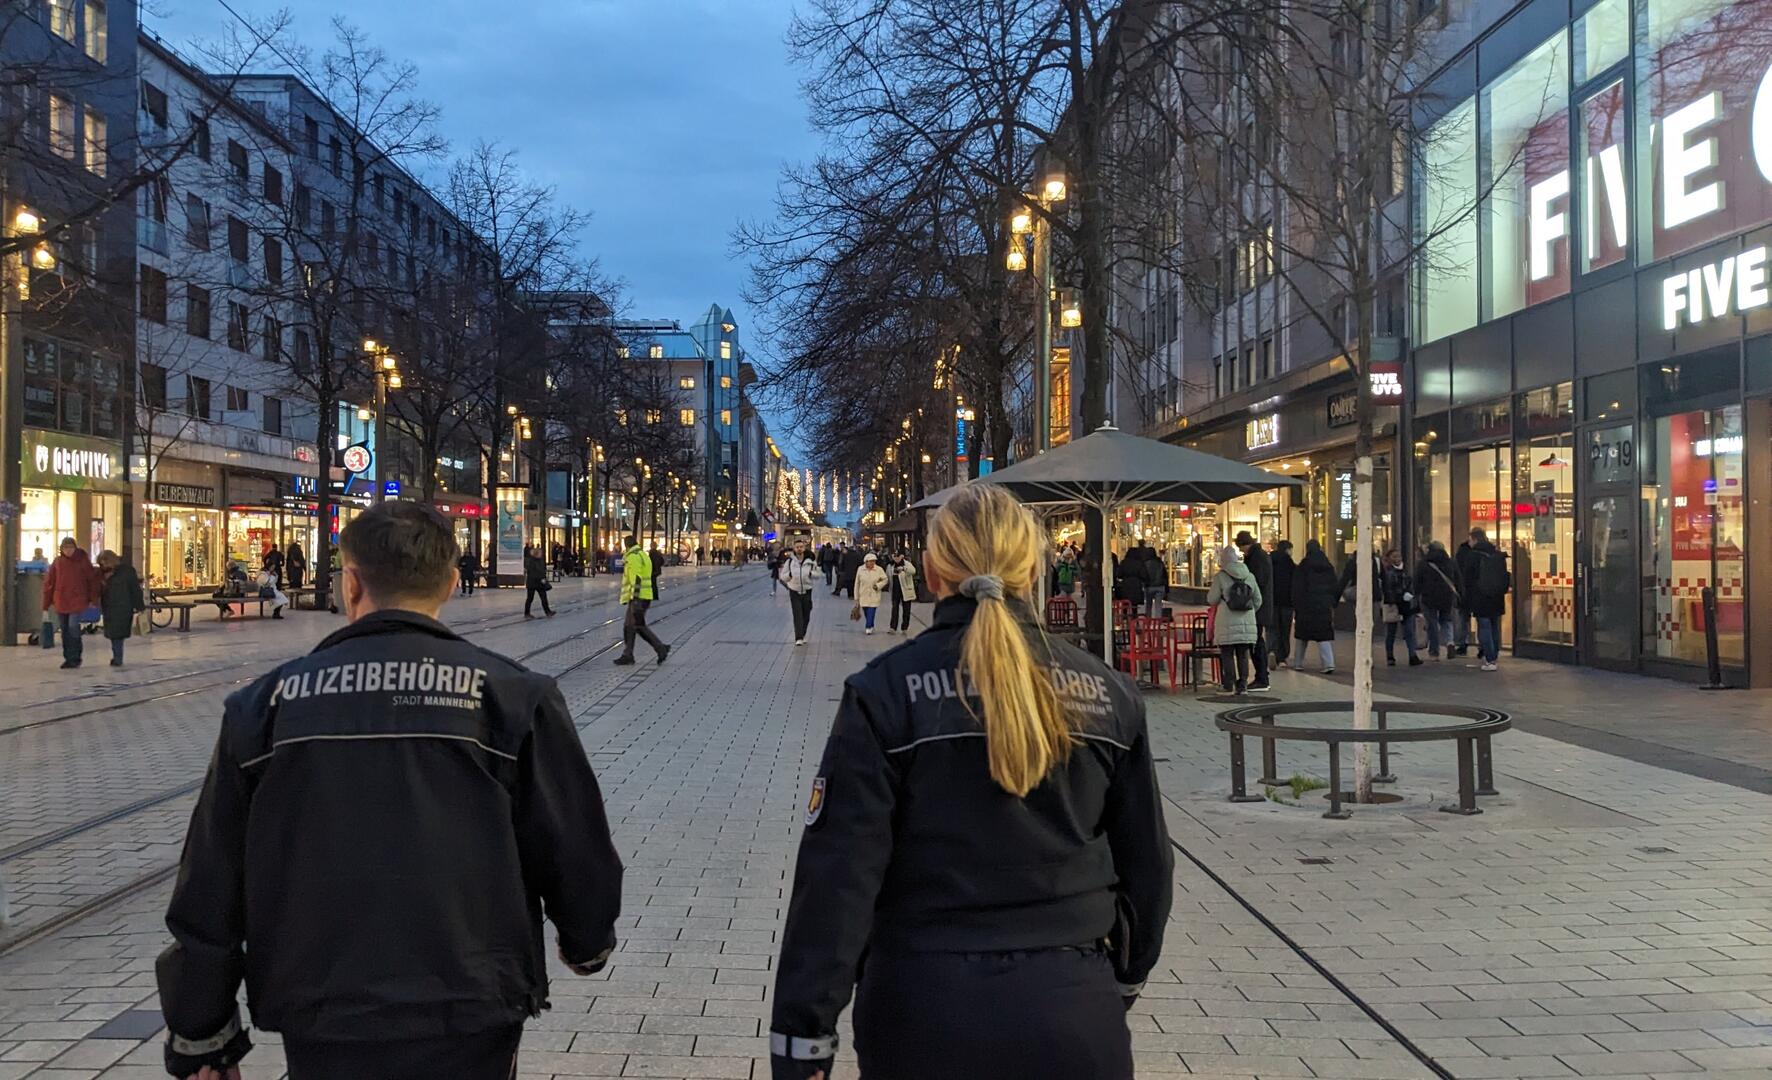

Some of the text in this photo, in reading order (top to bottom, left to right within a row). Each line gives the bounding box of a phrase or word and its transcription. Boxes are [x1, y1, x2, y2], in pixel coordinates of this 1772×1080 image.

[1663, 246, 1768, 330] FIVE
[1370, 383, 1402, 395] UYS
[158, 484, 215, 504] ELBENWALD
[392, 696, 422, 706] STADT
